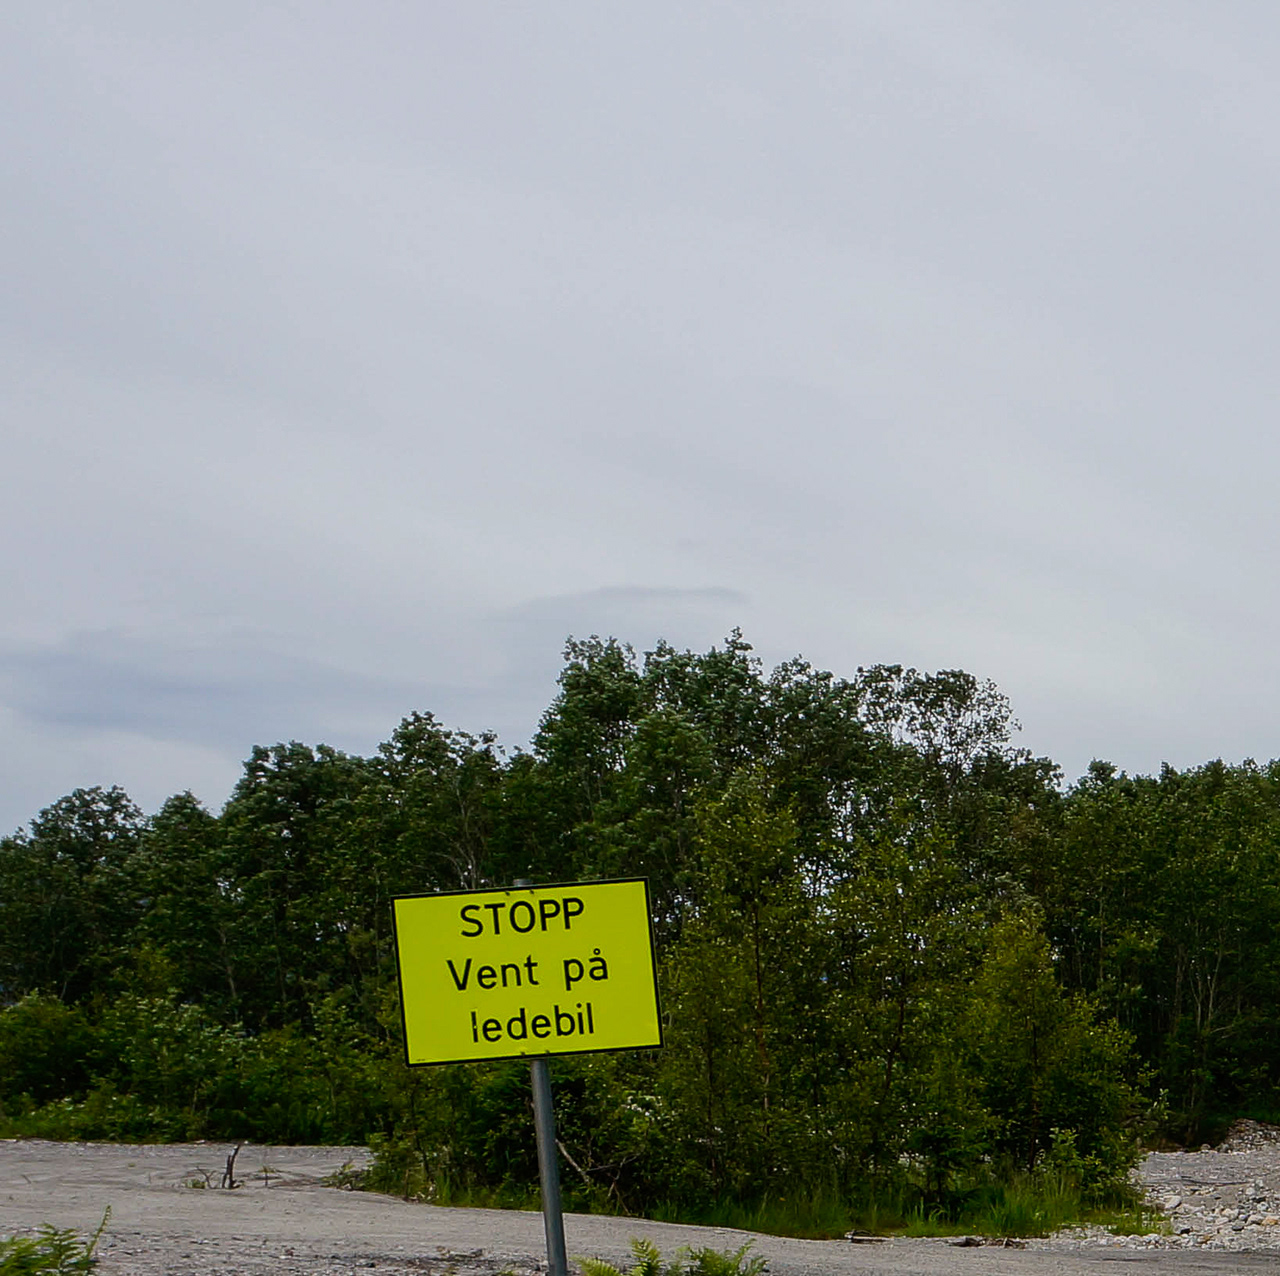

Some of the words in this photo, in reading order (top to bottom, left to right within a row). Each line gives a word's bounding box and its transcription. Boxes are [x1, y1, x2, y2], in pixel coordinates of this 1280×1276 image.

[459, 897, 585, 938] STOPP
[446, 955, 540, 991] Vent
[562, 948, 609, 991] på
[470, 1002, 595, 1043] ledebil
